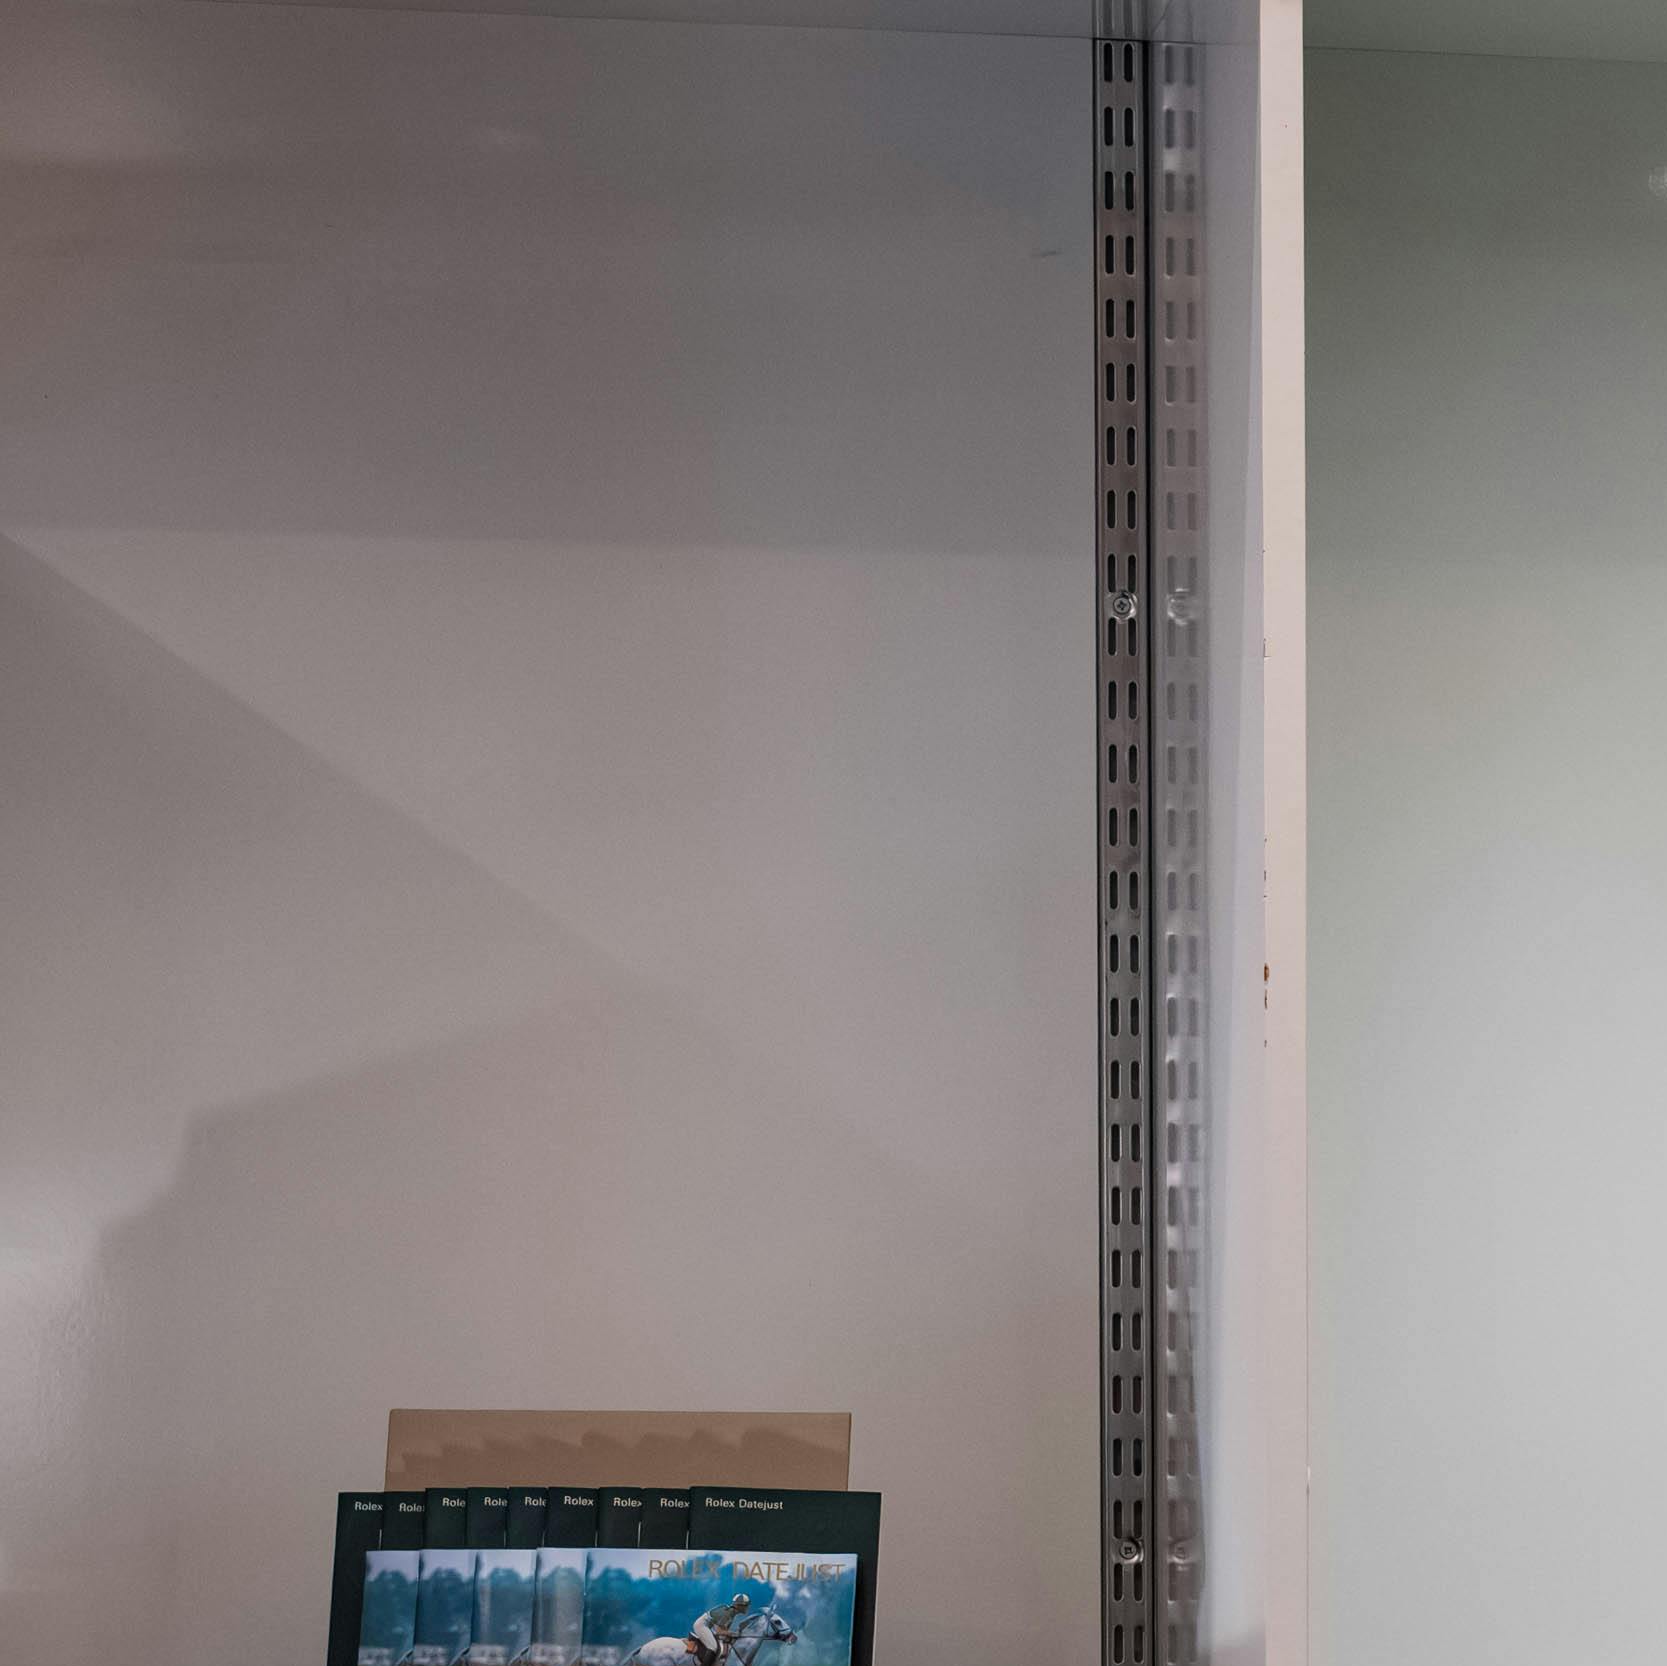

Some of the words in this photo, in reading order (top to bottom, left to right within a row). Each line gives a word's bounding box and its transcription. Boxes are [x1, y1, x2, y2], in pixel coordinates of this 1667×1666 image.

[564, 1496, 594, 1506] Rolex
[705, 1498, 735, 1508] Rolex
[738, 1499, 783, 1511] Datejust
[649, 1560, 720, 1578] ROLEX
[733, 1561, 846, 1583] DATEJUST
